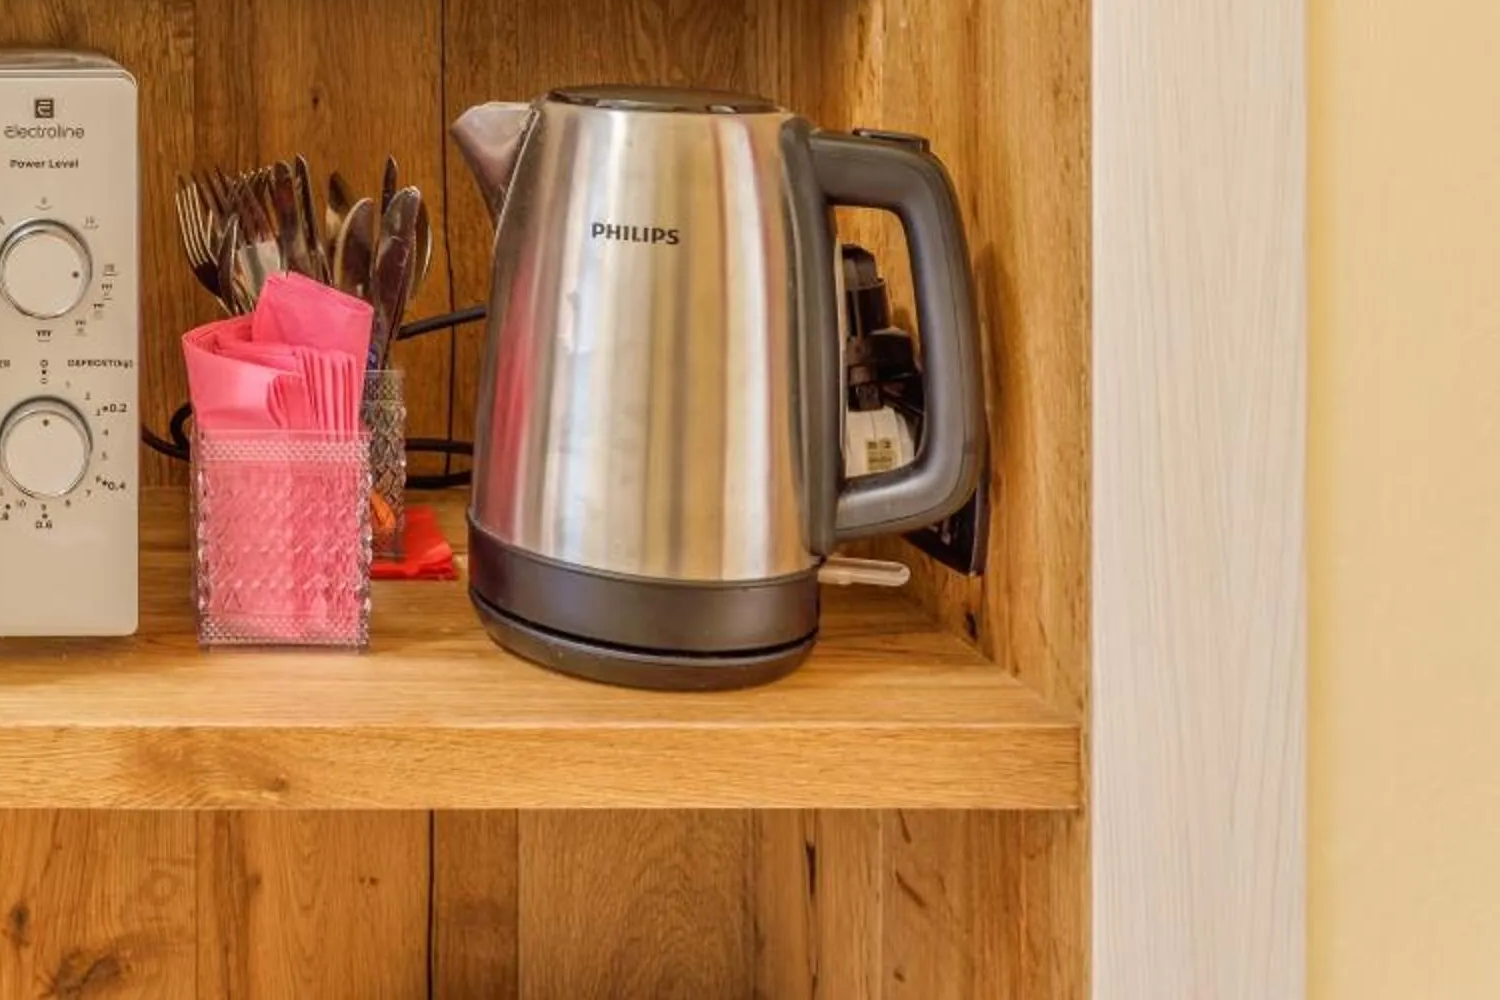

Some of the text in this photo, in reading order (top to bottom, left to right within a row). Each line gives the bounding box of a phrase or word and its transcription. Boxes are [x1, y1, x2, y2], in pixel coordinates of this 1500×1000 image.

[10, 158, 79, 169] Power Level
[591, 222, 680, 245] PHILIPS
[109, 403, 128, 413] 0.2
[107, 481, 127, 492] 0.4
